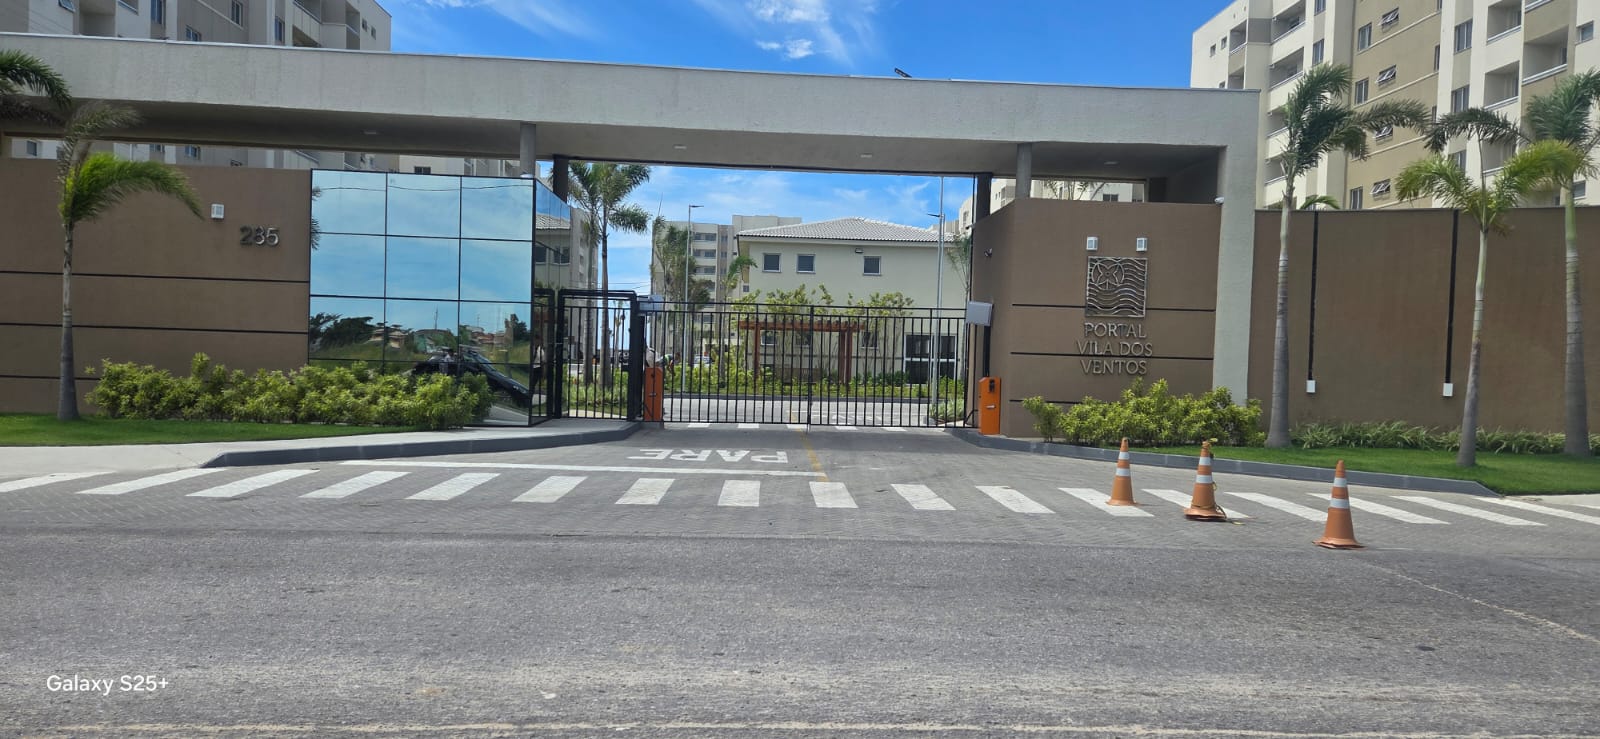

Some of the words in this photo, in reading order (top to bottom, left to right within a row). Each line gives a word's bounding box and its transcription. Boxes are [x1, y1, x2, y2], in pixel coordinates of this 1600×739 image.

[1084, 322, 1147, 338] PORTAL
[1077, 340, 1113, 355] VILA
[1119, 341, 1153, 357] DOS
[1080, 359, 1147, 375] VENTOS
[626, 449, 789, 464] PARE
